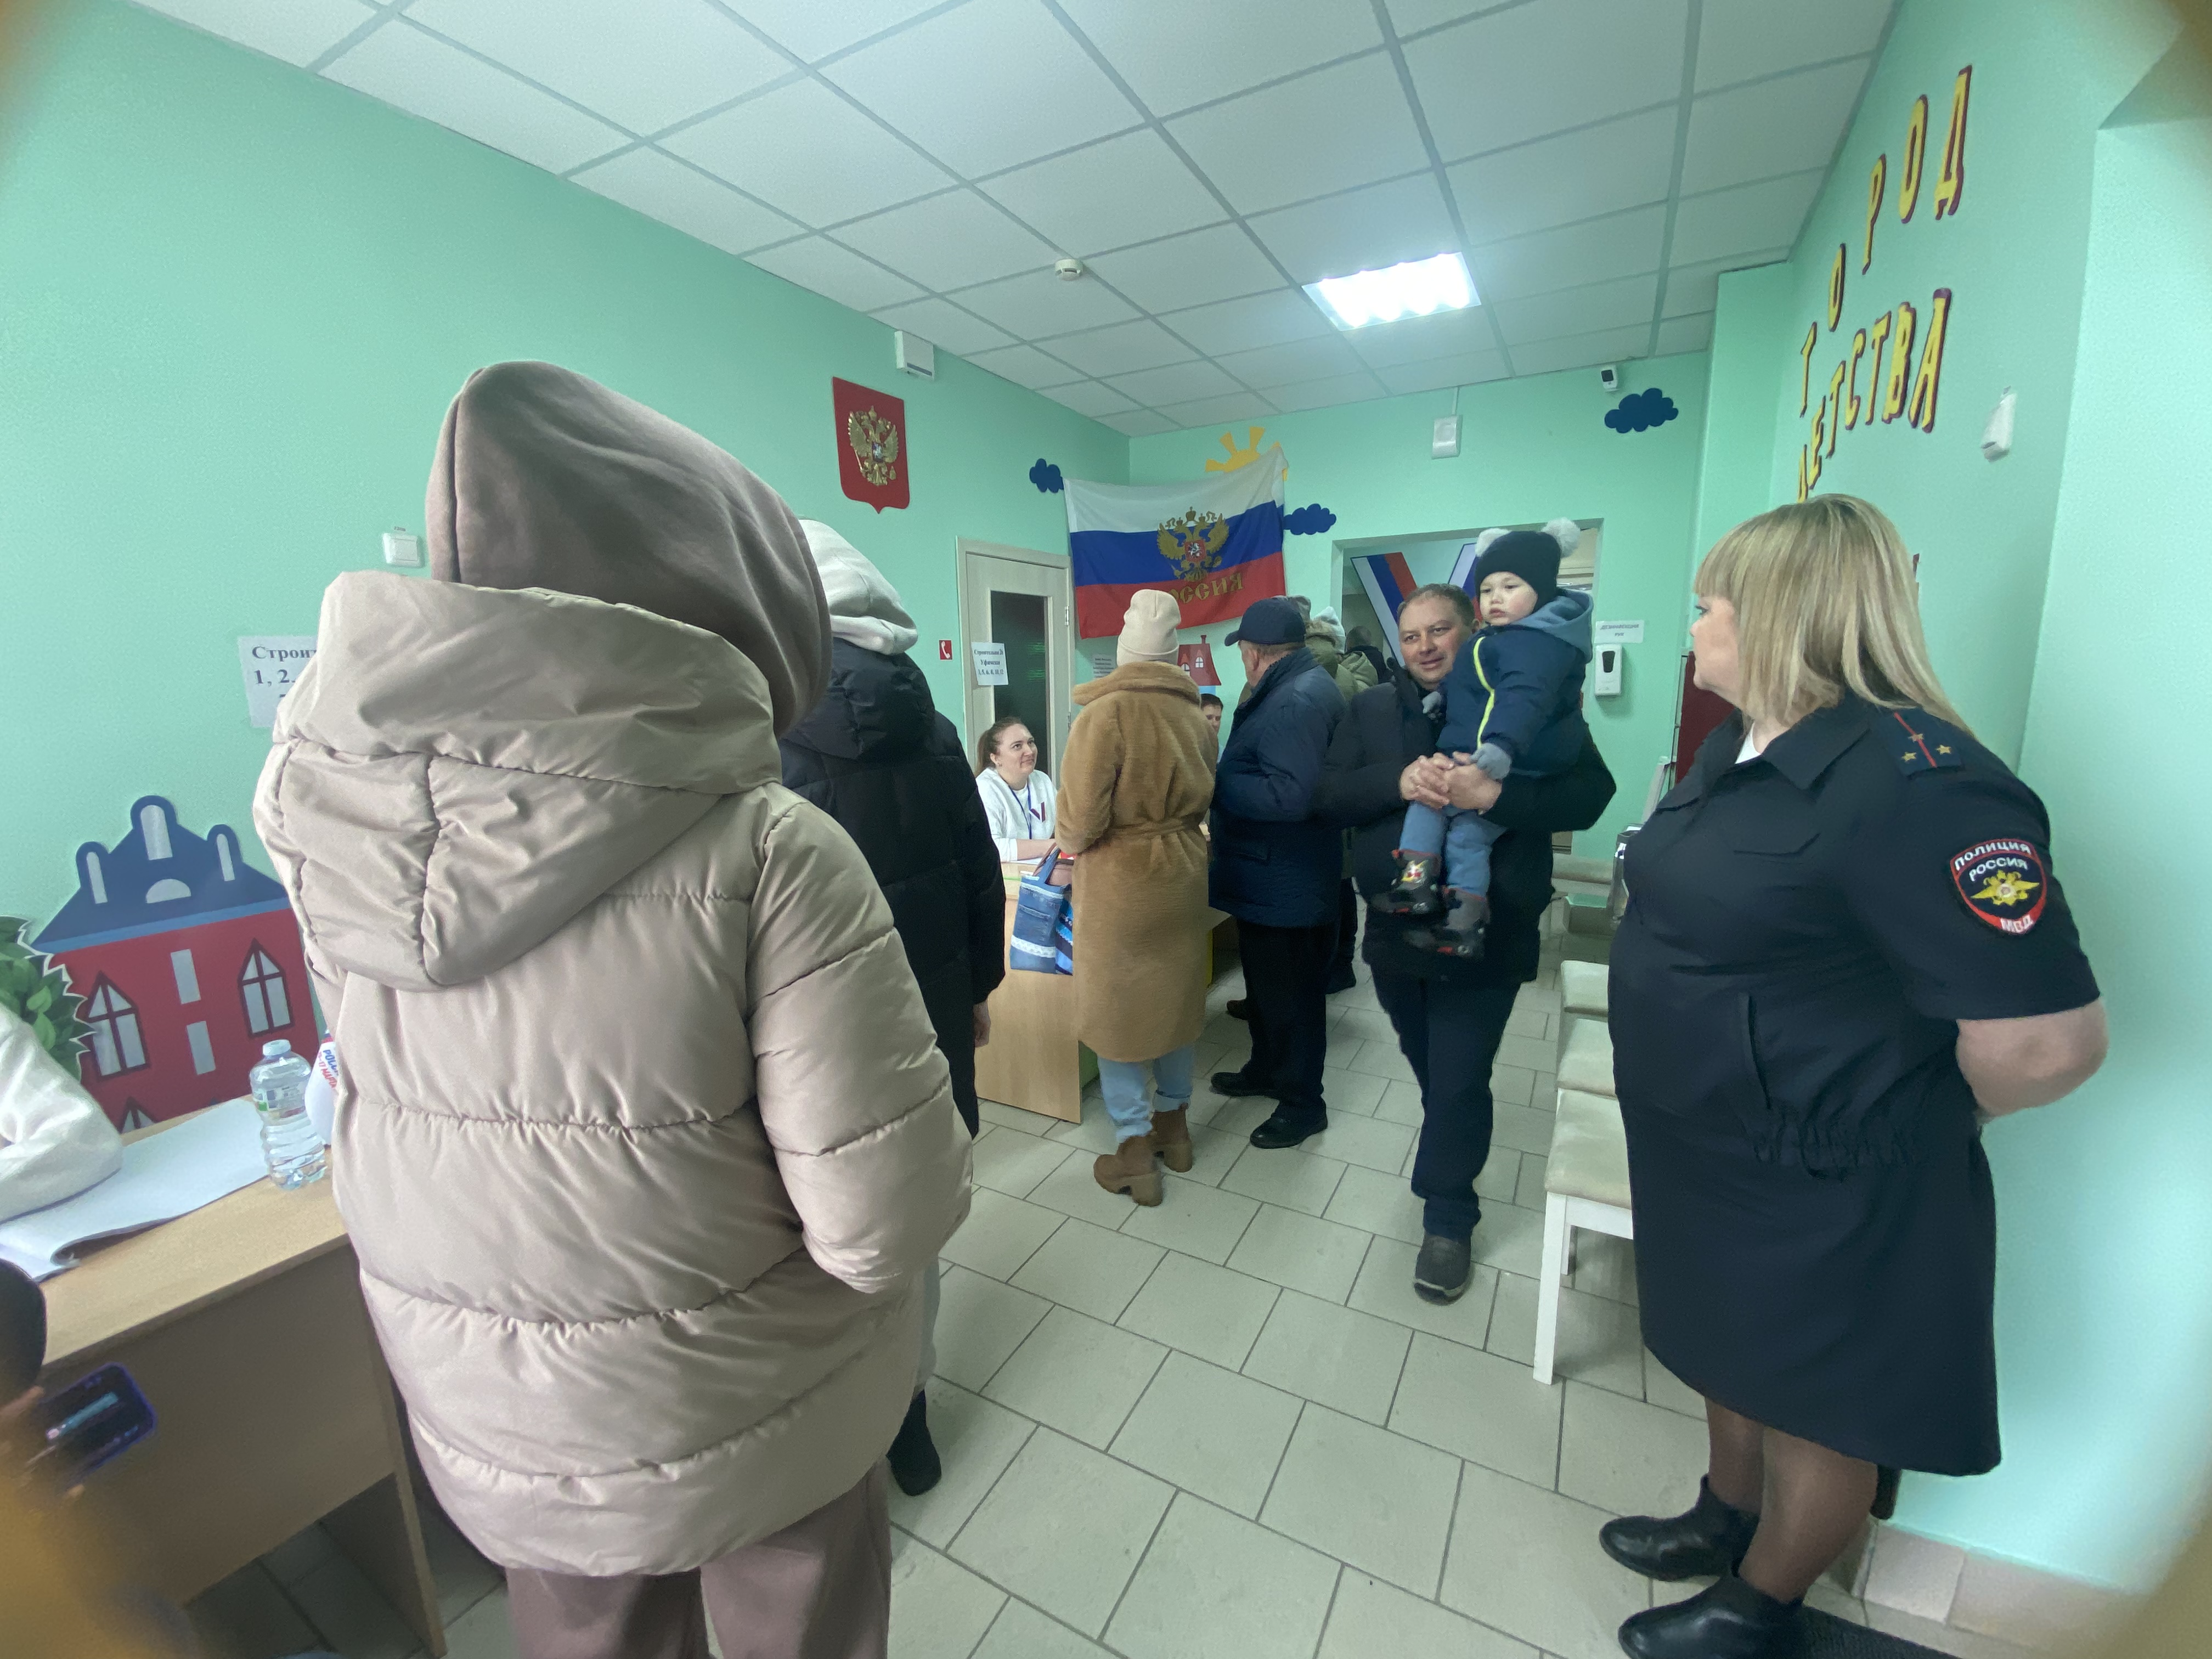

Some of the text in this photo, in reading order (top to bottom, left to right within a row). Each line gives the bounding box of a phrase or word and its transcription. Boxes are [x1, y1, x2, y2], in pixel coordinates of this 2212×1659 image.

[1800, 64, 1972, 418] ГОРОД
[253, 669, 272, 686] 1,
[1954, 841, 2032, 871] ПОЛИЦИЯ
[1969, 857, 2028, 881] РОССИЯ
[2000, 914, 2033, 932] МВД
